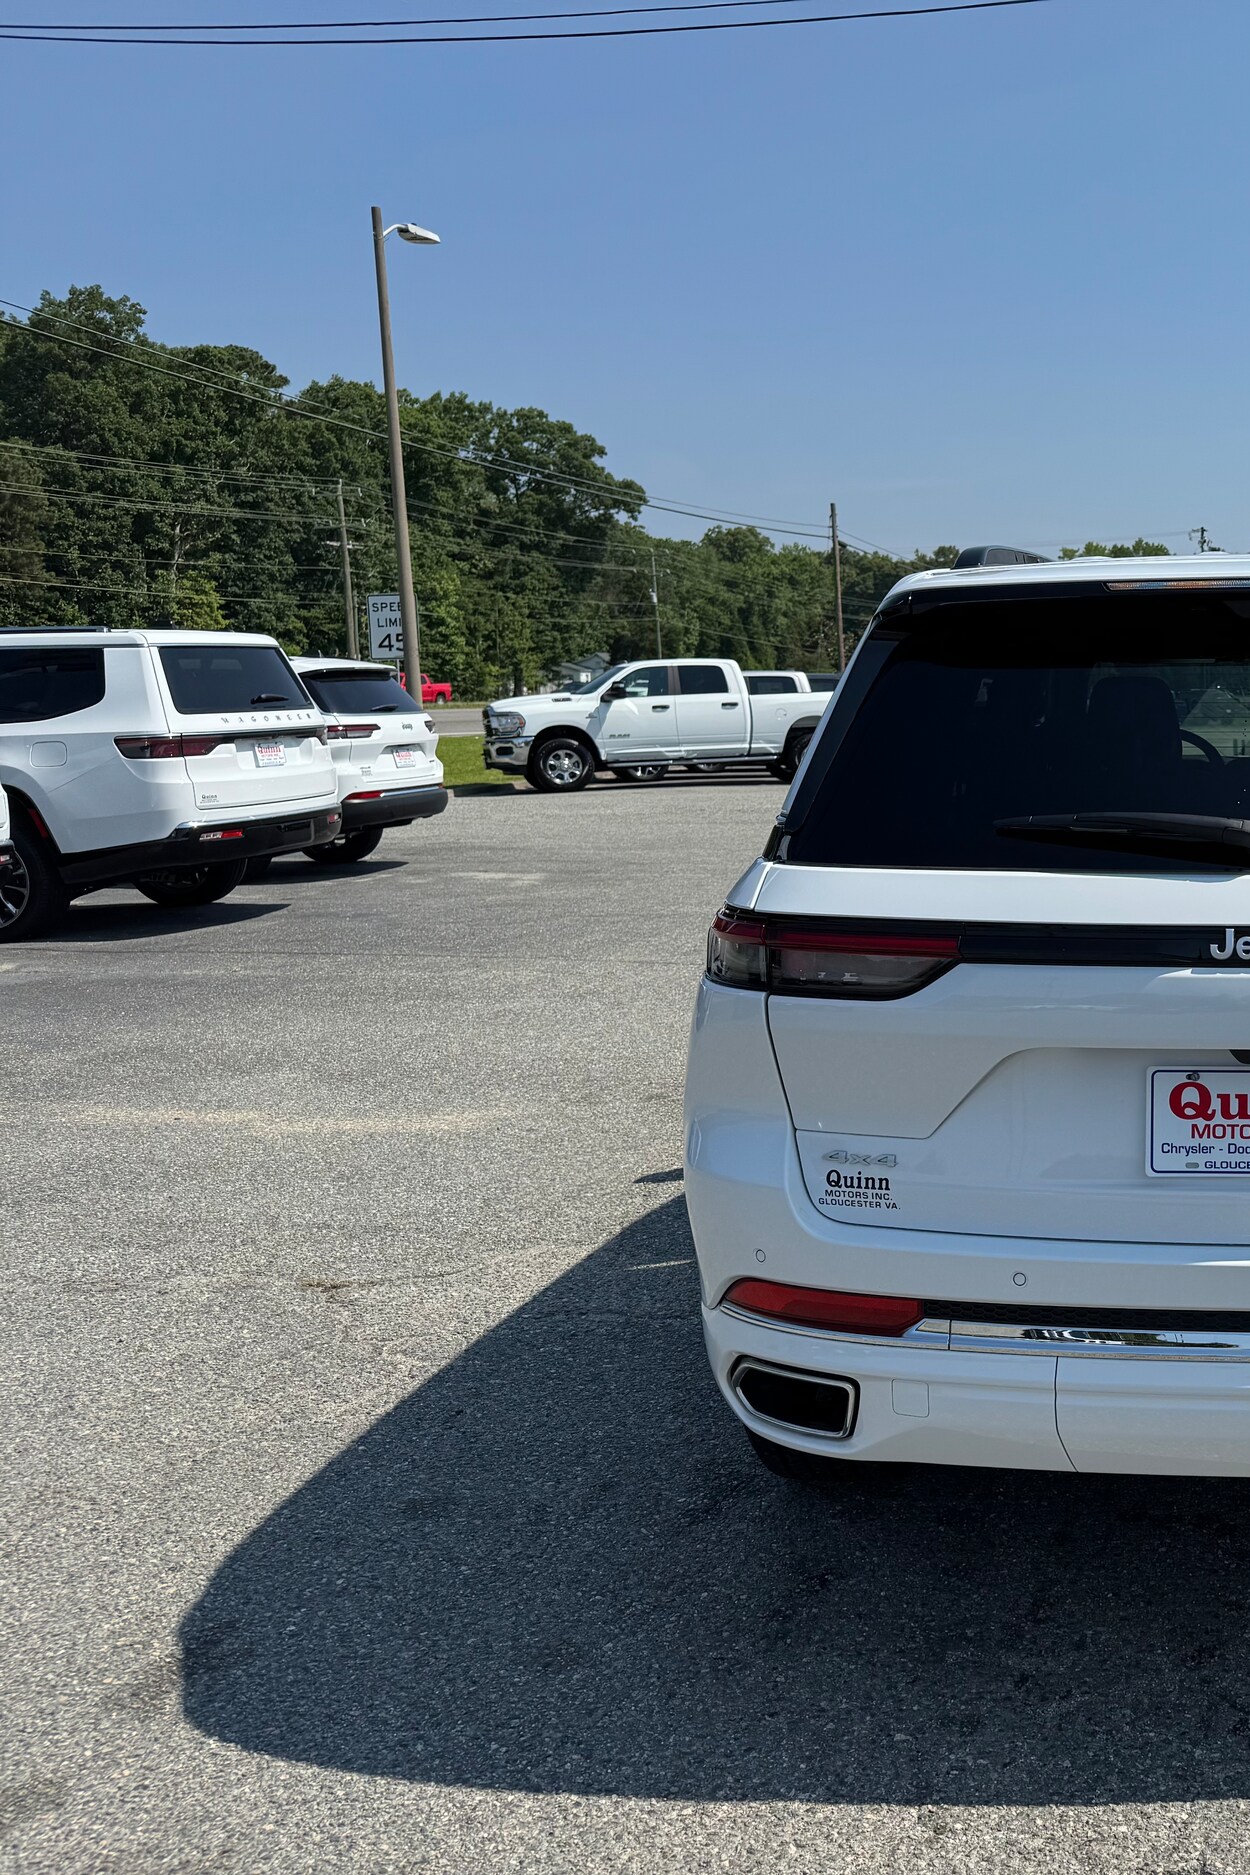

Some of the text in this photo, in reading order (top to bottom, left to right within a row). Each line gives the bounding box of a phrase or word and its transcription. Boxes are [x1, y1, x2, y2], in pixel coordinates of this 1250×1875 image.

[371, 602, 401, 612] SPE
[377, 617, 402, 628] LIMI
[378, 633, 404, 652] 45
[220, 713, 312, 724] WAGONEER
[257, 745, 281, 754] Quinn
[1161, 1142, 1215, 1157] Chrysler
[822, 1149, 899, 1168] 4x4
[826, 1169, 891, 1191] Quinn
[824, 1189, 893, 1201] MOTORS INC.
[818, 1197, 901, 1210] GLOUCESTER VA.
